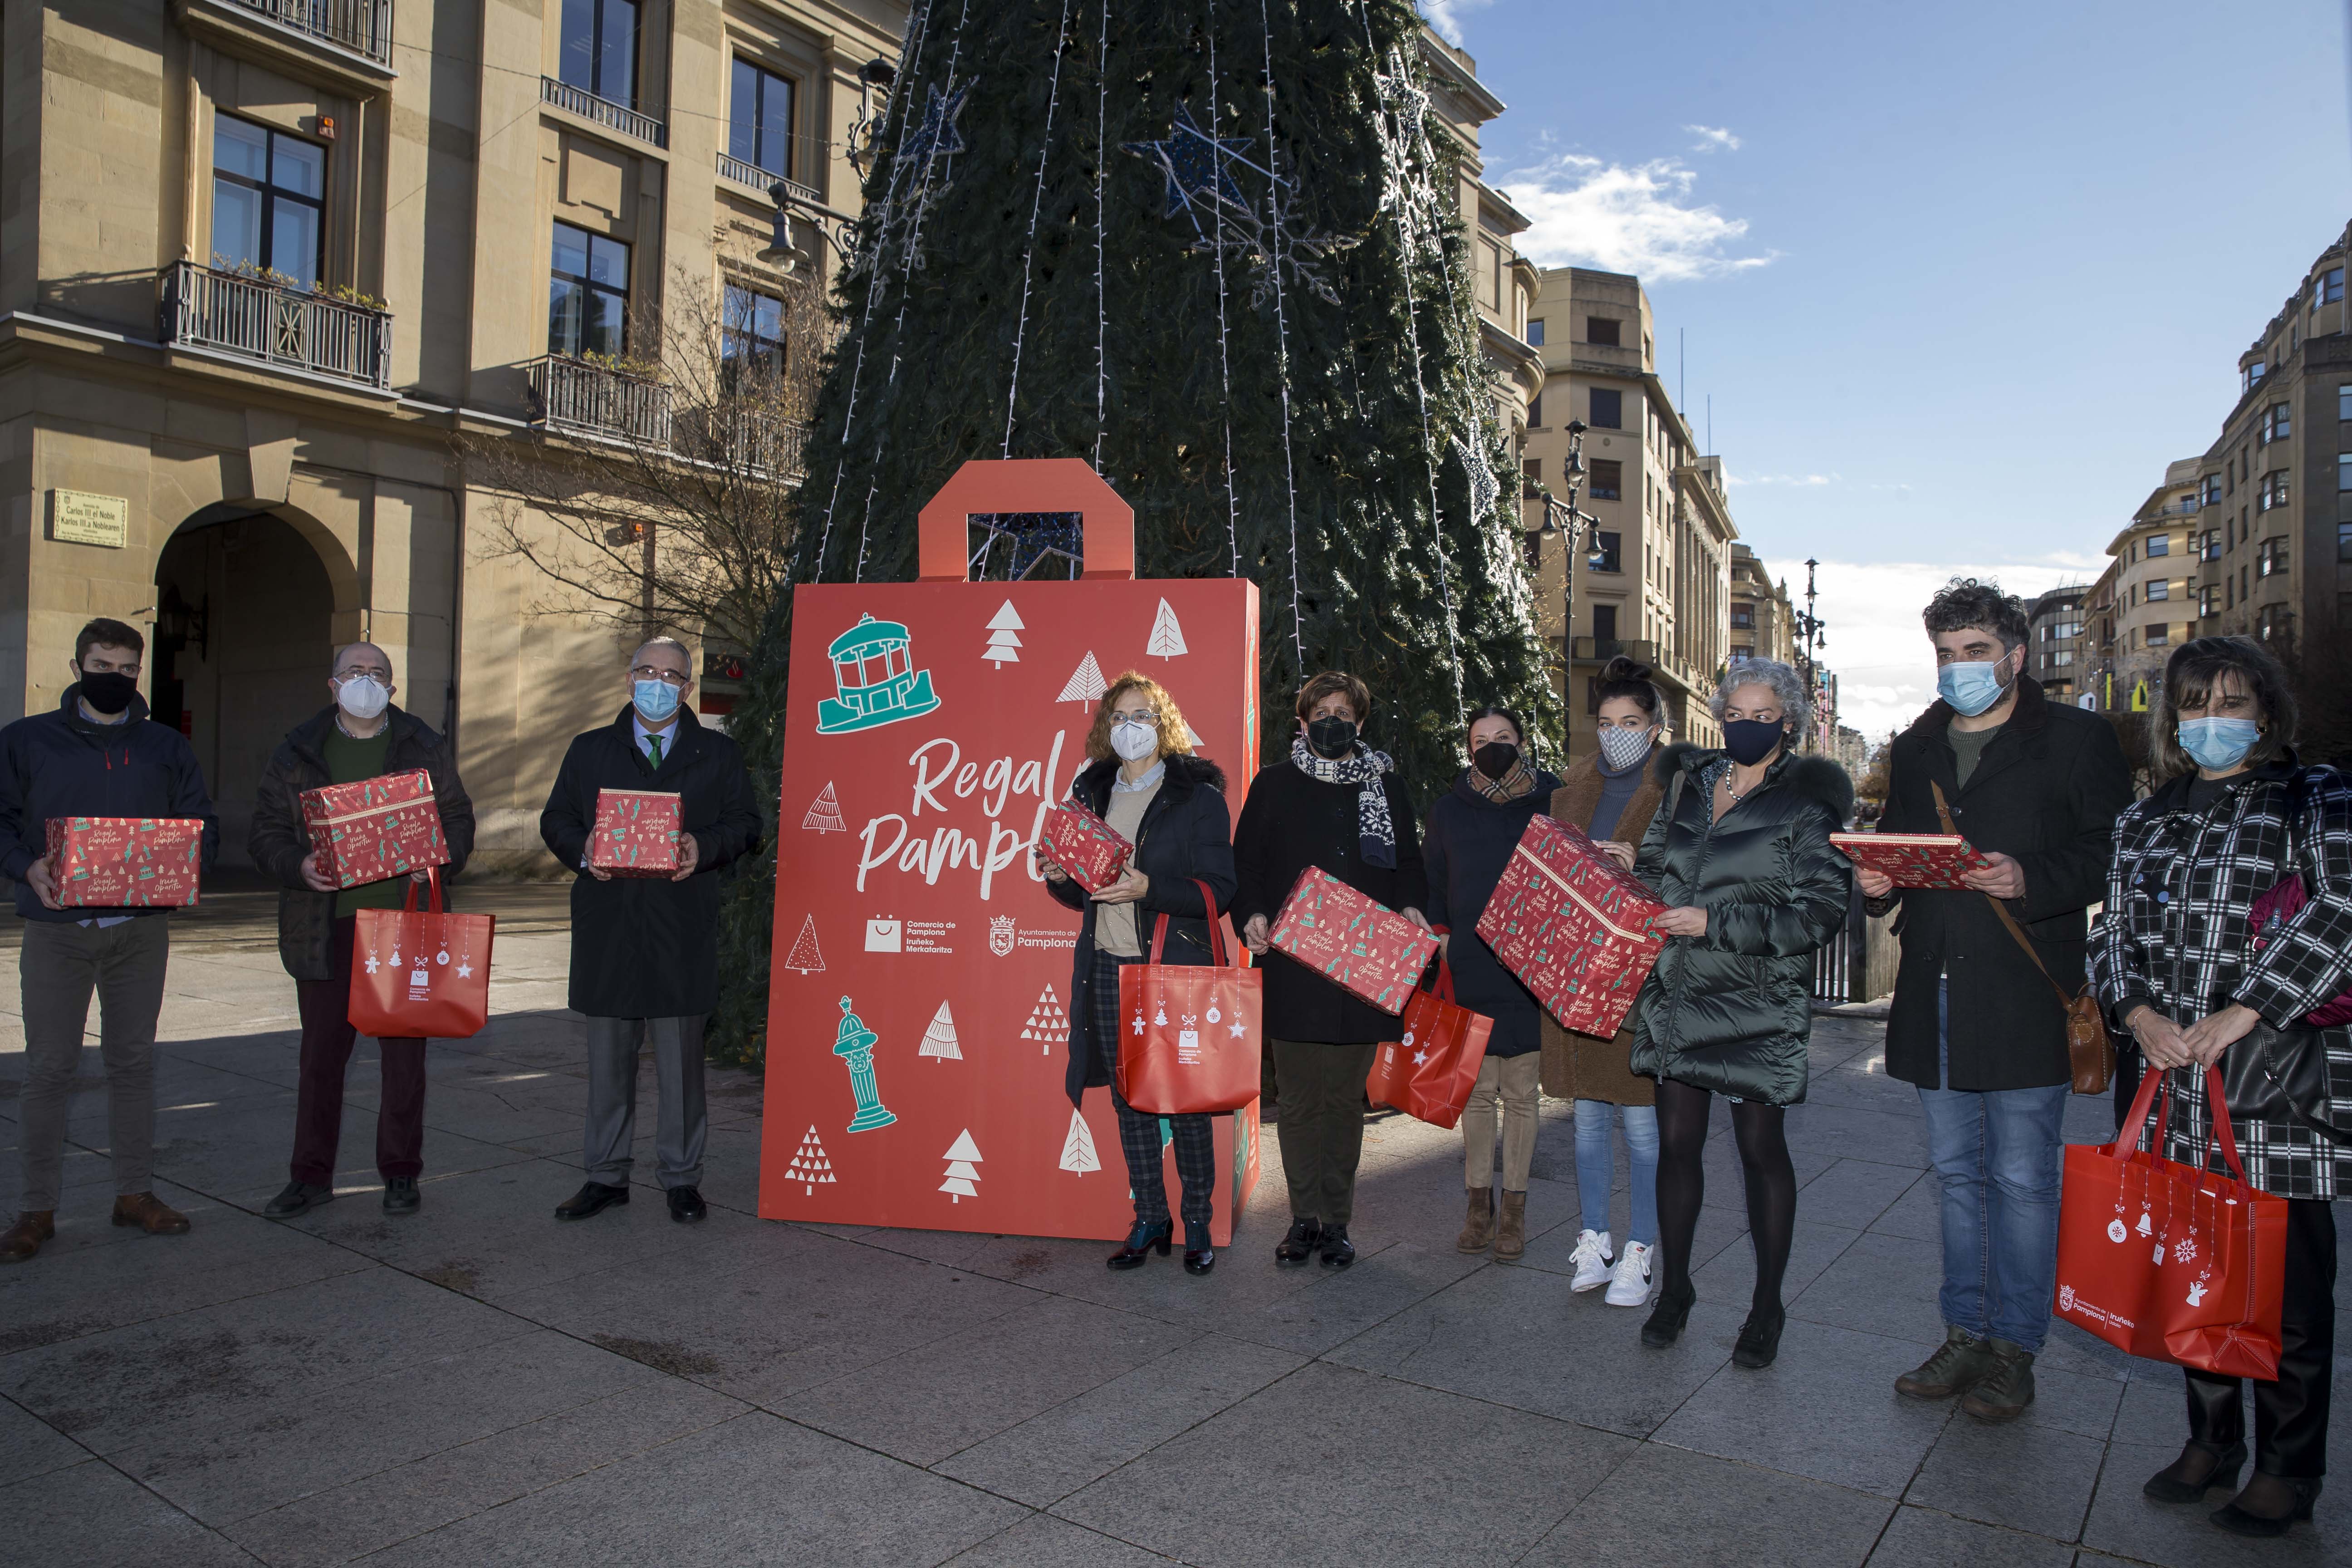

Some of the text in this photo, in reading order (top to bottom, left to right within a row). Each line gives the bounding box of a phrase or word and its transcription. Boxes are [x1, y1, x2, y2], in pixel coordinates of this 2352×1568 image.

[66, 506, 83, 516] Carlos
[100, 510, 115, 520] Noble
[61, 516, 78, 526] Karlos
[93, 521, 120, 532] Noblearen
[857, 800, 1048, 901] Pampl
[907, 928, 946, 936] Pamplona
[1018, 937, 1076, 950] Pamplona
[2073, 1303, 2105, 1321] Pamplona
[2075, 1298, 2101, 1312] Ayuntamiento
[2109, 1319, 2121, 1328] Udala
[2110, 1313, 2134, 1328] Iruñeko
